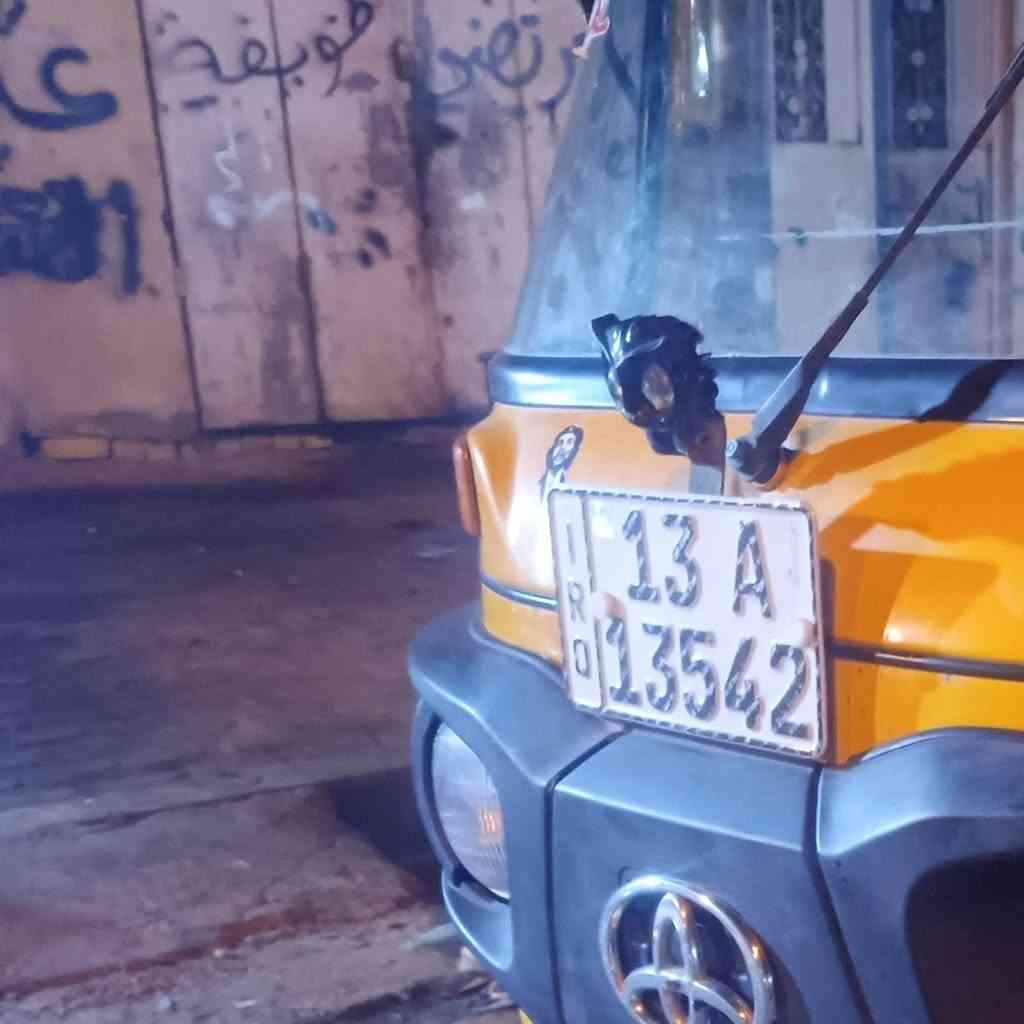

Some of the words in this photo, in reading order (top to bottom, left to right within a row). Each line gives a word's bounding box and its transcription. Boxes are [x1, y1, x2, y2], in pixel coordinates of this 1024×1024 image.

[623, 510, 698, 607] 13
[732, 520, 773, 618] A
[606, 615, 813, 738] 13542
